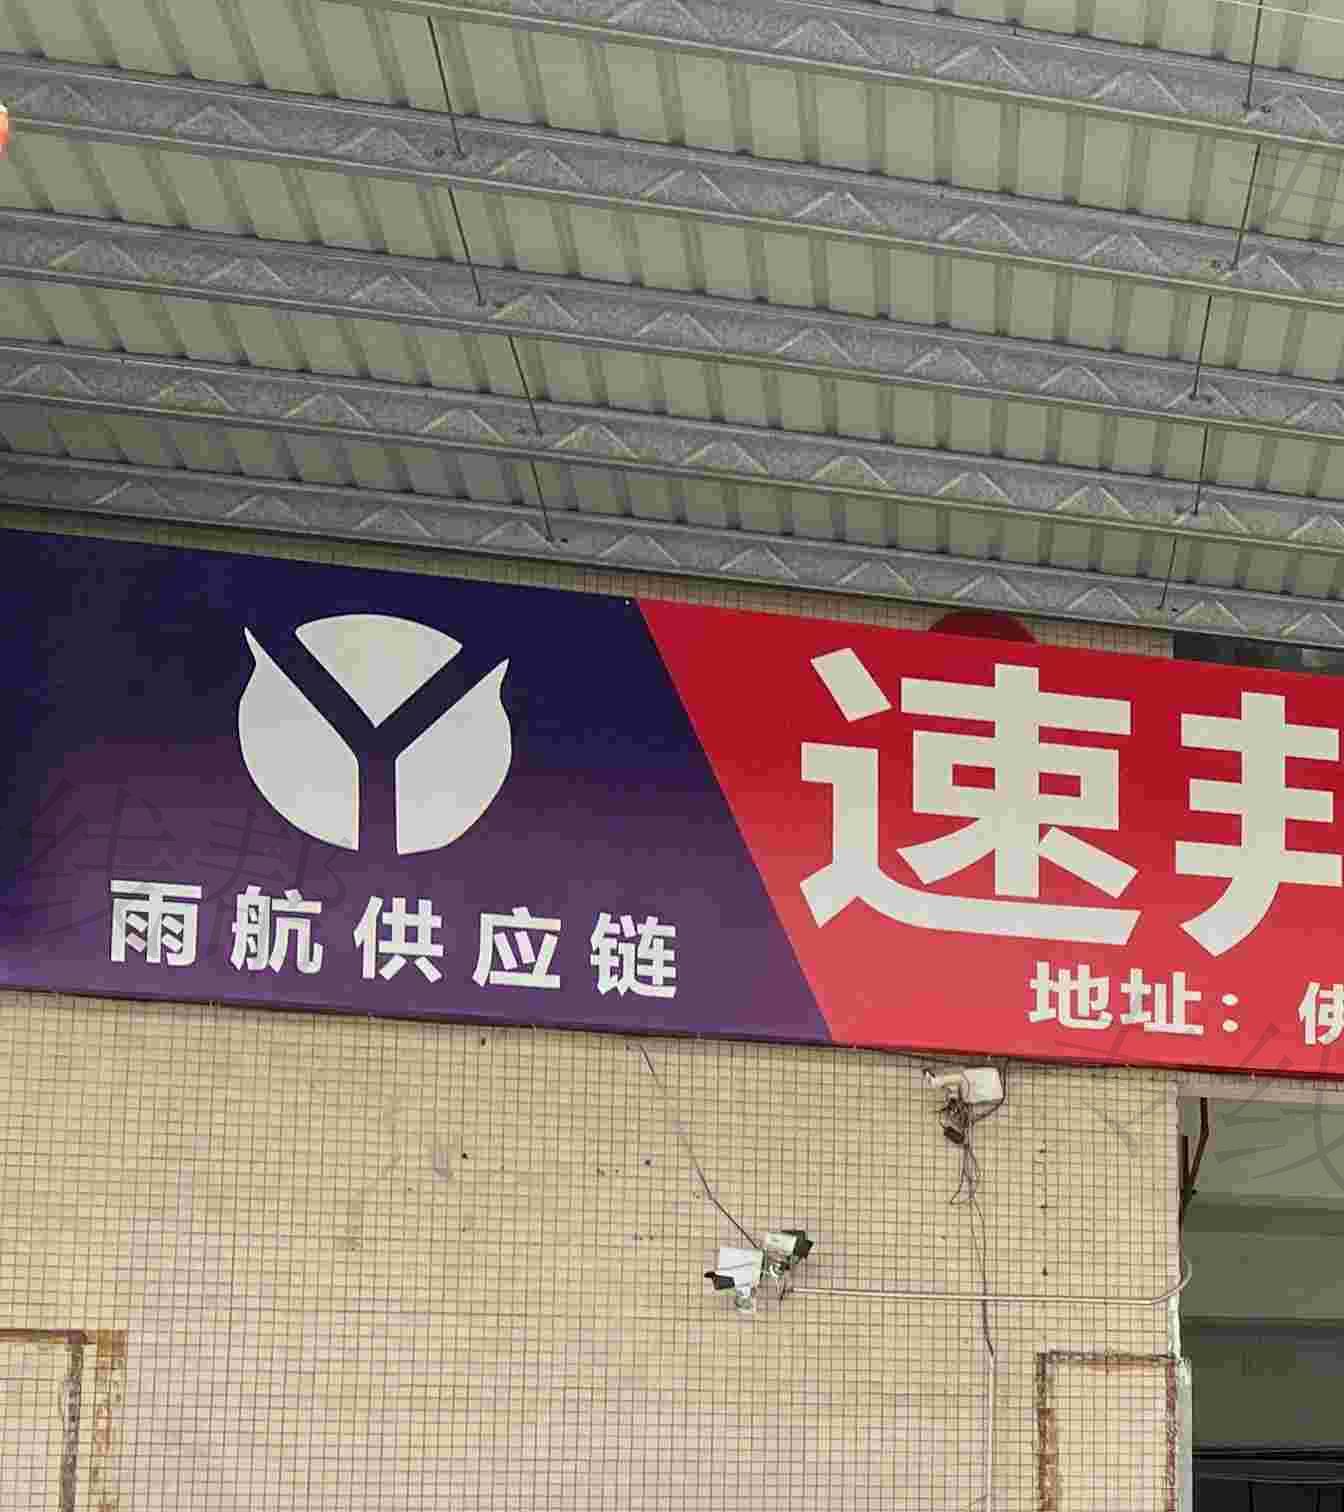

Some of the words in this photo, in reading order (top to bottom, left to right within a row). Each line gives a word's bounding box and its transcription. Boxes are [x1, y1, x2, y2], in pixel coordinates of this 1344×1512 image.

[109, 879, 678, 999] 雨航供应链
